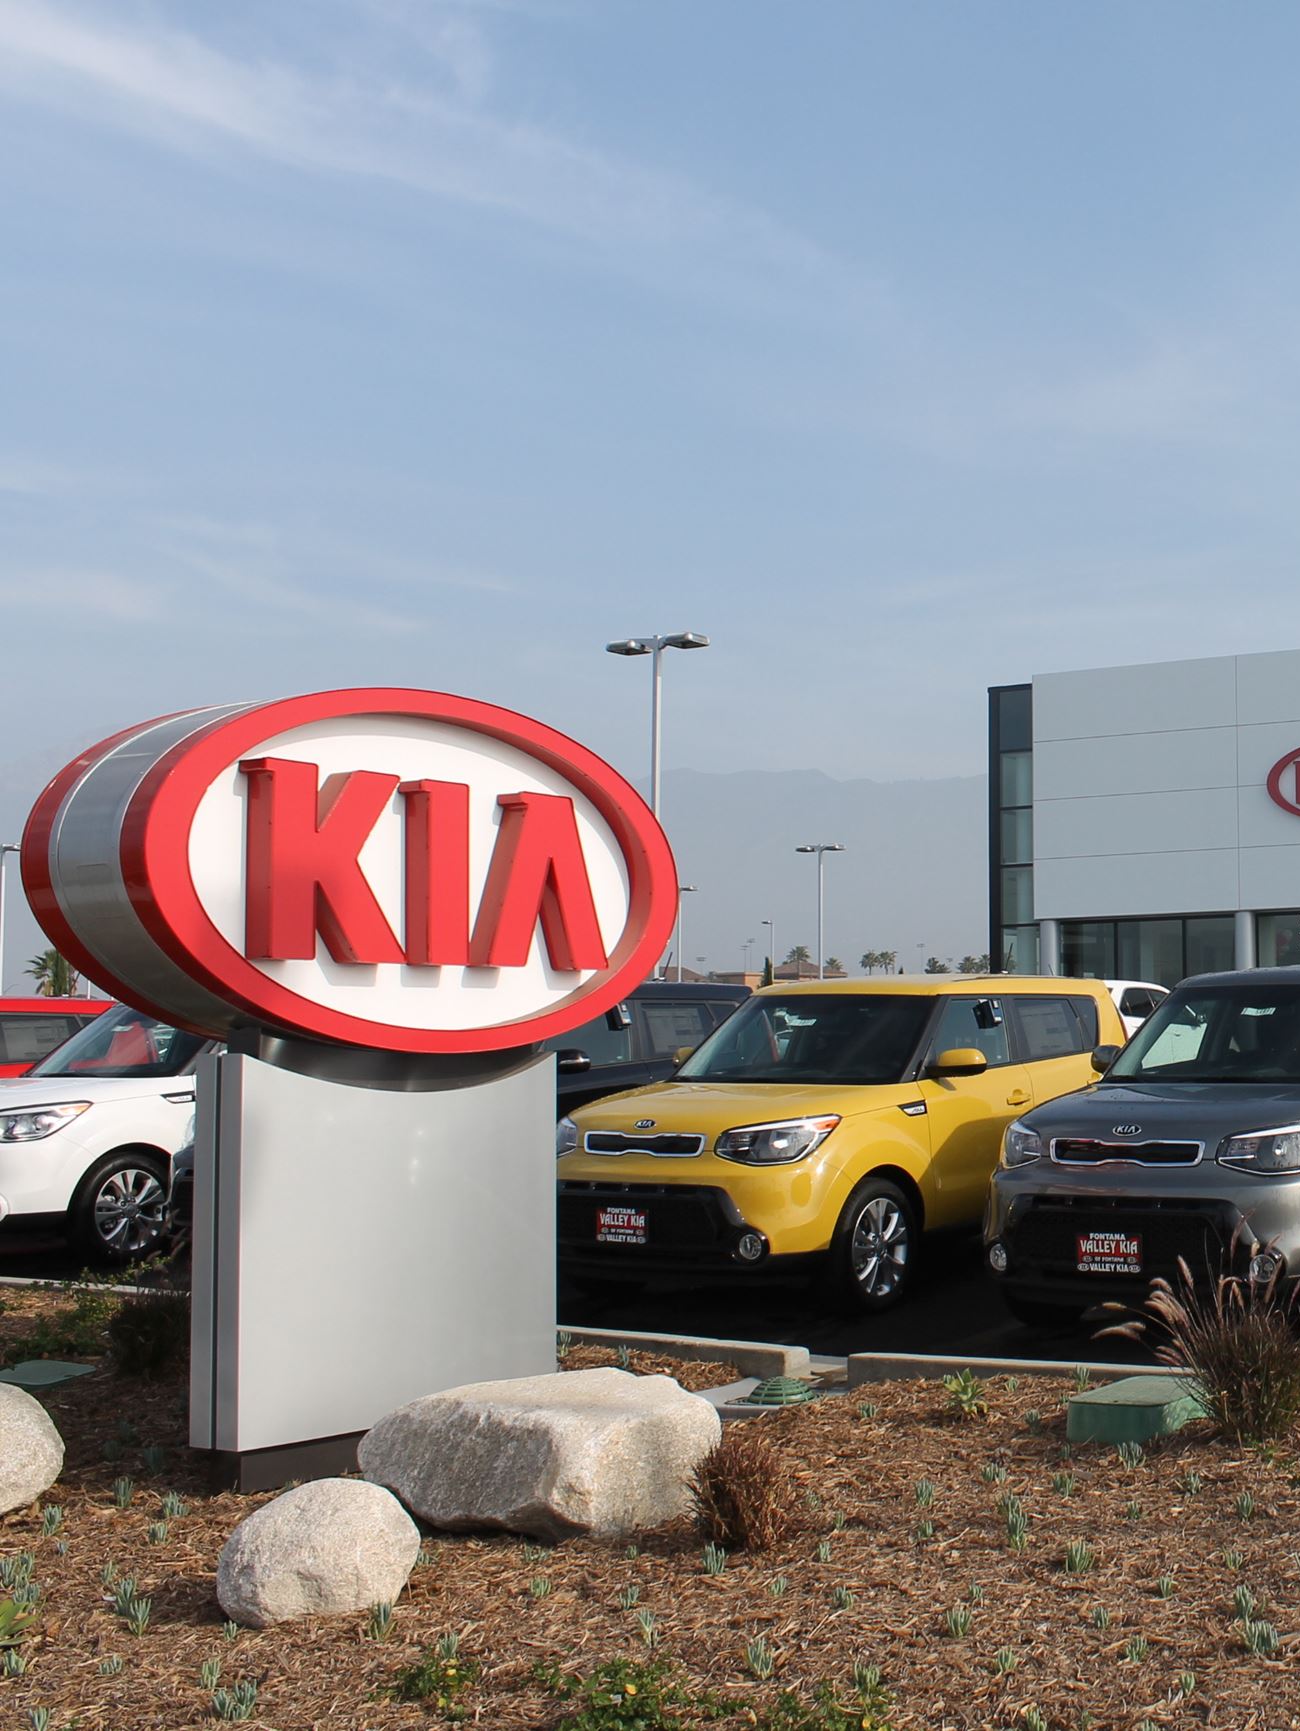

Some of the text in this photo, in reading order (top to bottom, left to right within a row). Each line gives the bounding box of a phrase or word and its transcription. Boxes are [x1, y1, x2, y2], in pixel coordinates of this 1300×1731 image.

[239, 756, 608, 970] KIA
[636, 1120, 652, 1128] KIA
[1117, 1125, 1136, 1133] KIA
[600, 1213, 645, 1228] VALLEY KIA
[1089, 1233, 1126, 1241] FONTANA
[1080, 1240, 1138, 1255] VALLEY KIA
[1089, 1263, 1115, 1272] VALLEY
[1116, 1264, 1128, 1272] KIA
